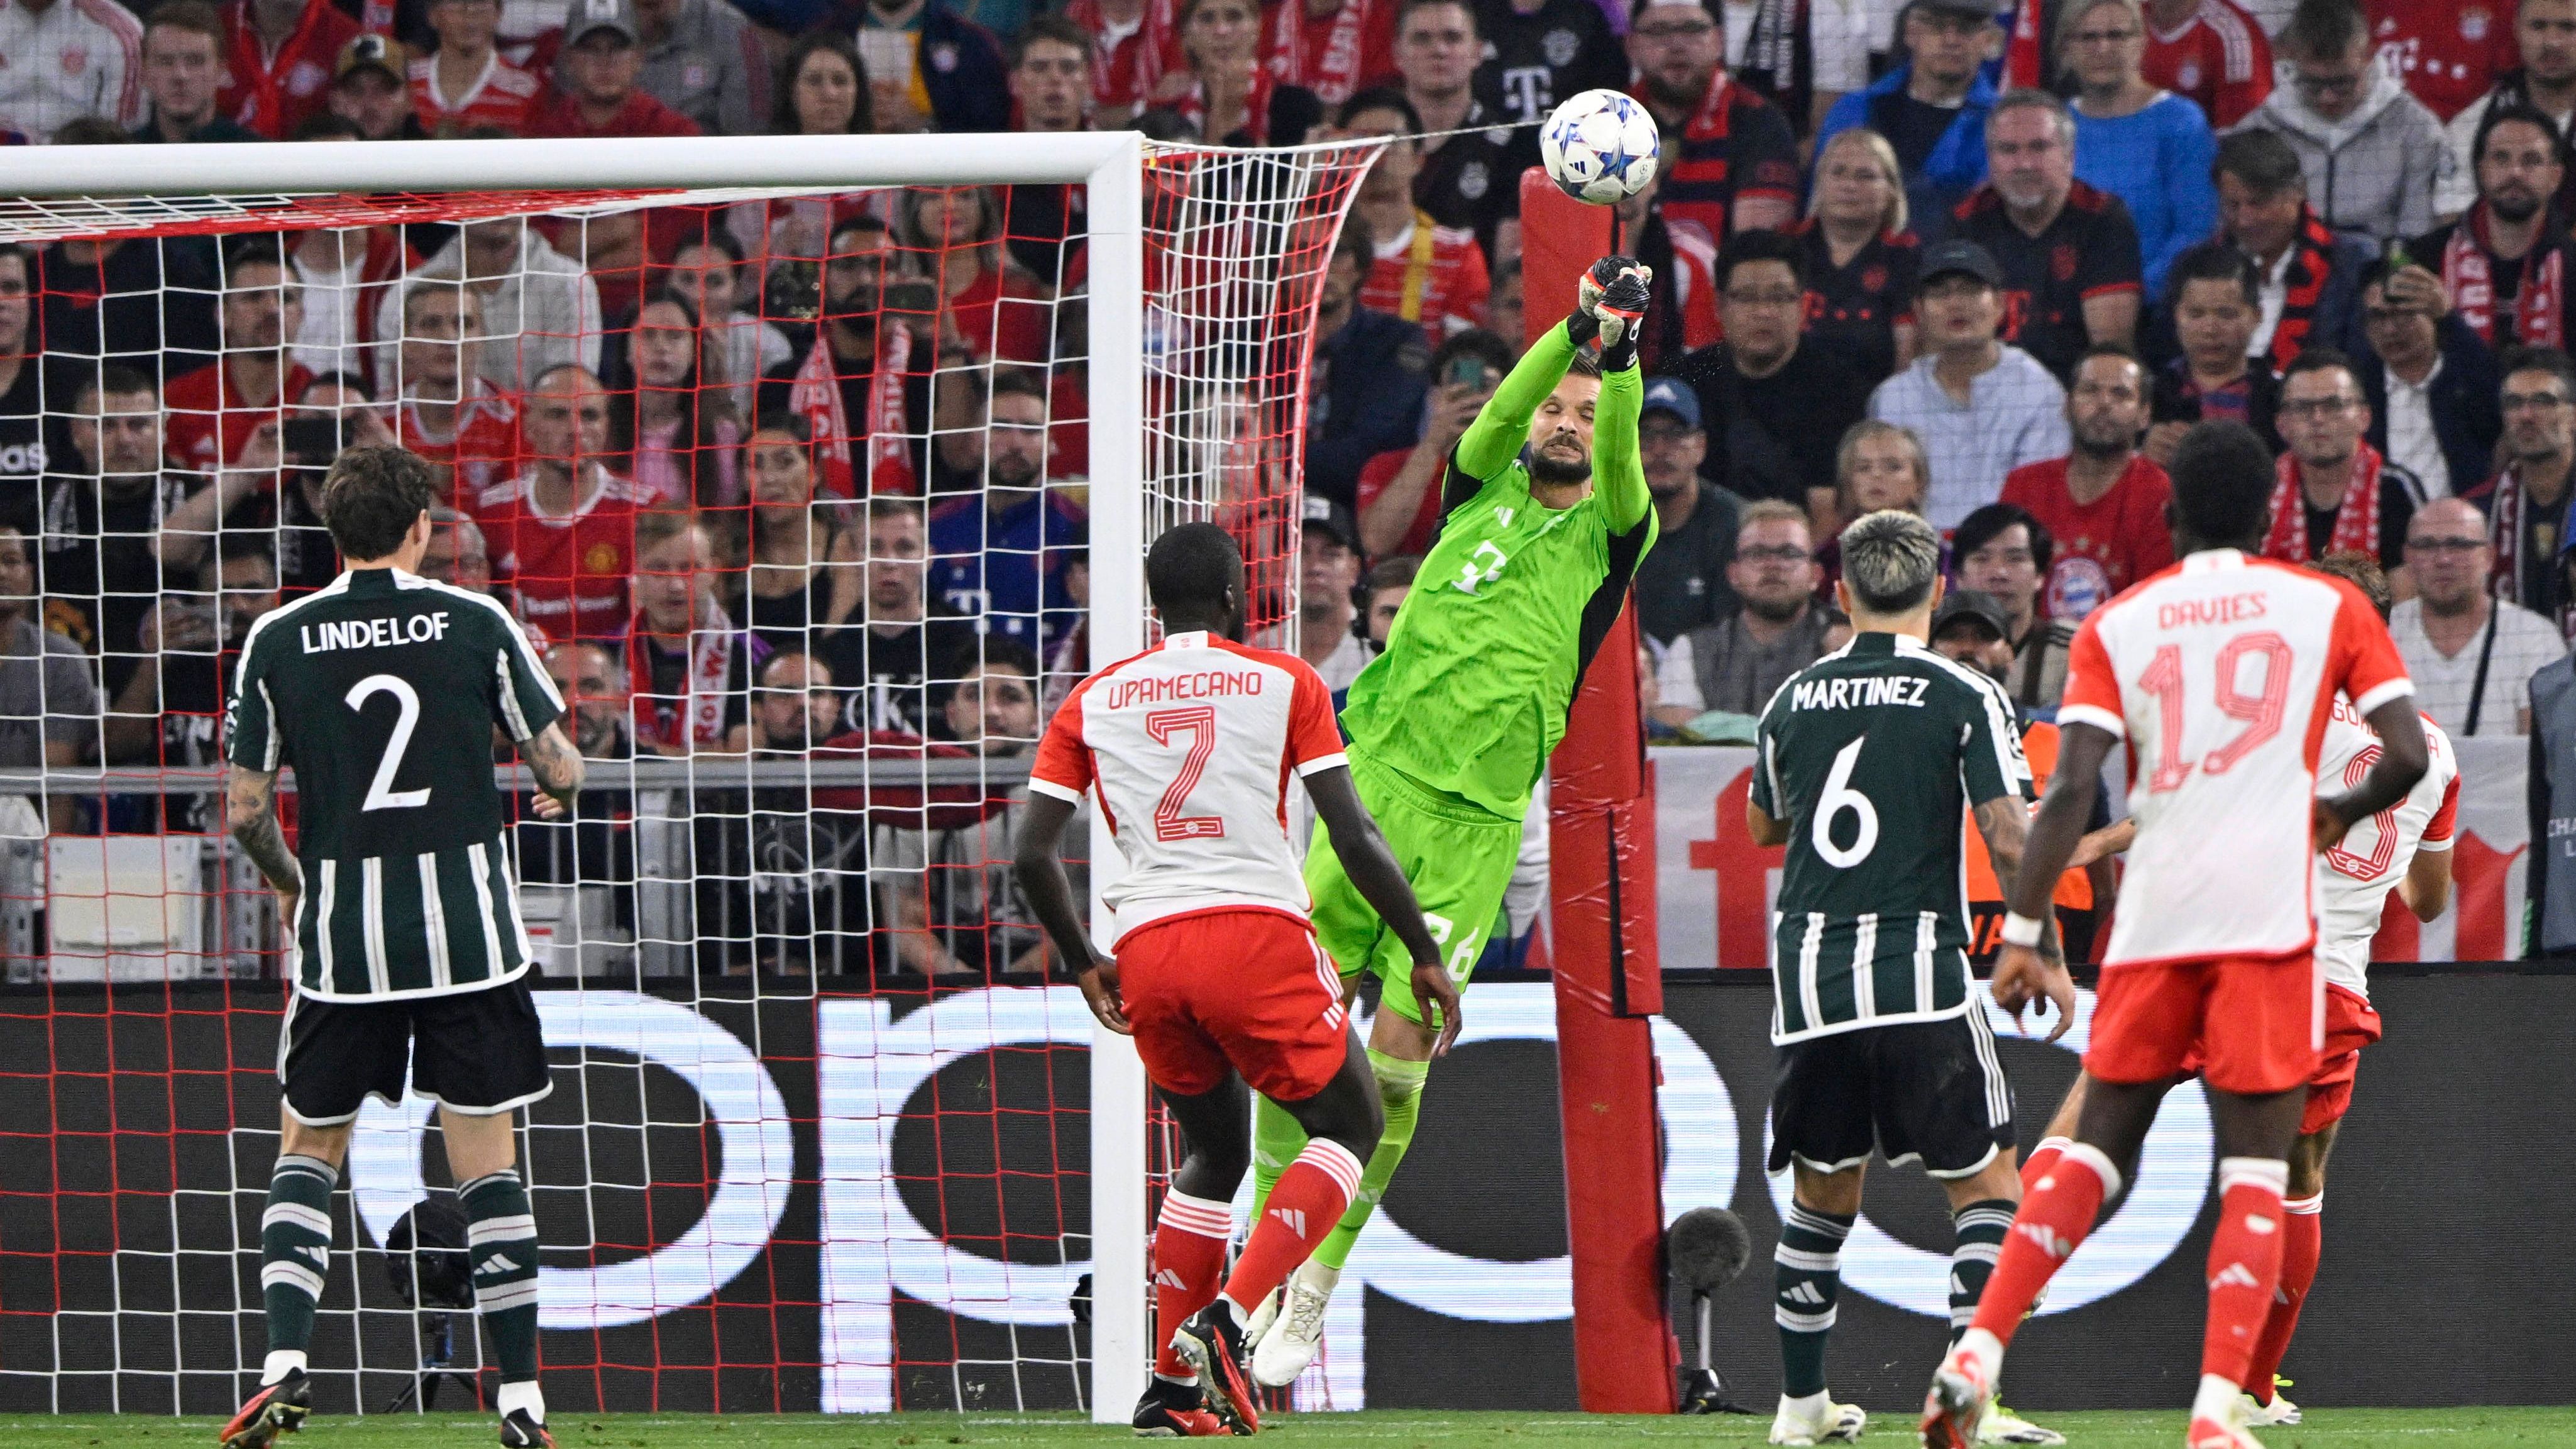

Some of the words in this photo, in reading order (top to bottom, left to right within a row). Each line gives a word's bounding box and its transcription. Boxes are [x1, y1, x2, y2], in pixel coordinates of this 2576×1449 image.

[1451, 539, 1509, 597] T
[2159, 590, 2268, 631] DAVIES
[301, 611, 449, 654] LINDELOF
[1109, 671, 1262, 710] UPAMECANO
[1792, 676, 1929, 712] MARTINEZ
[2138, 631, 2294, 793] 19
[345, 674, 434, 812] 2
[1146, 706, 1225, 842] 2
[1813, 736, 1879, 868] 6
[347, 986, 2216, 1414] oppo
